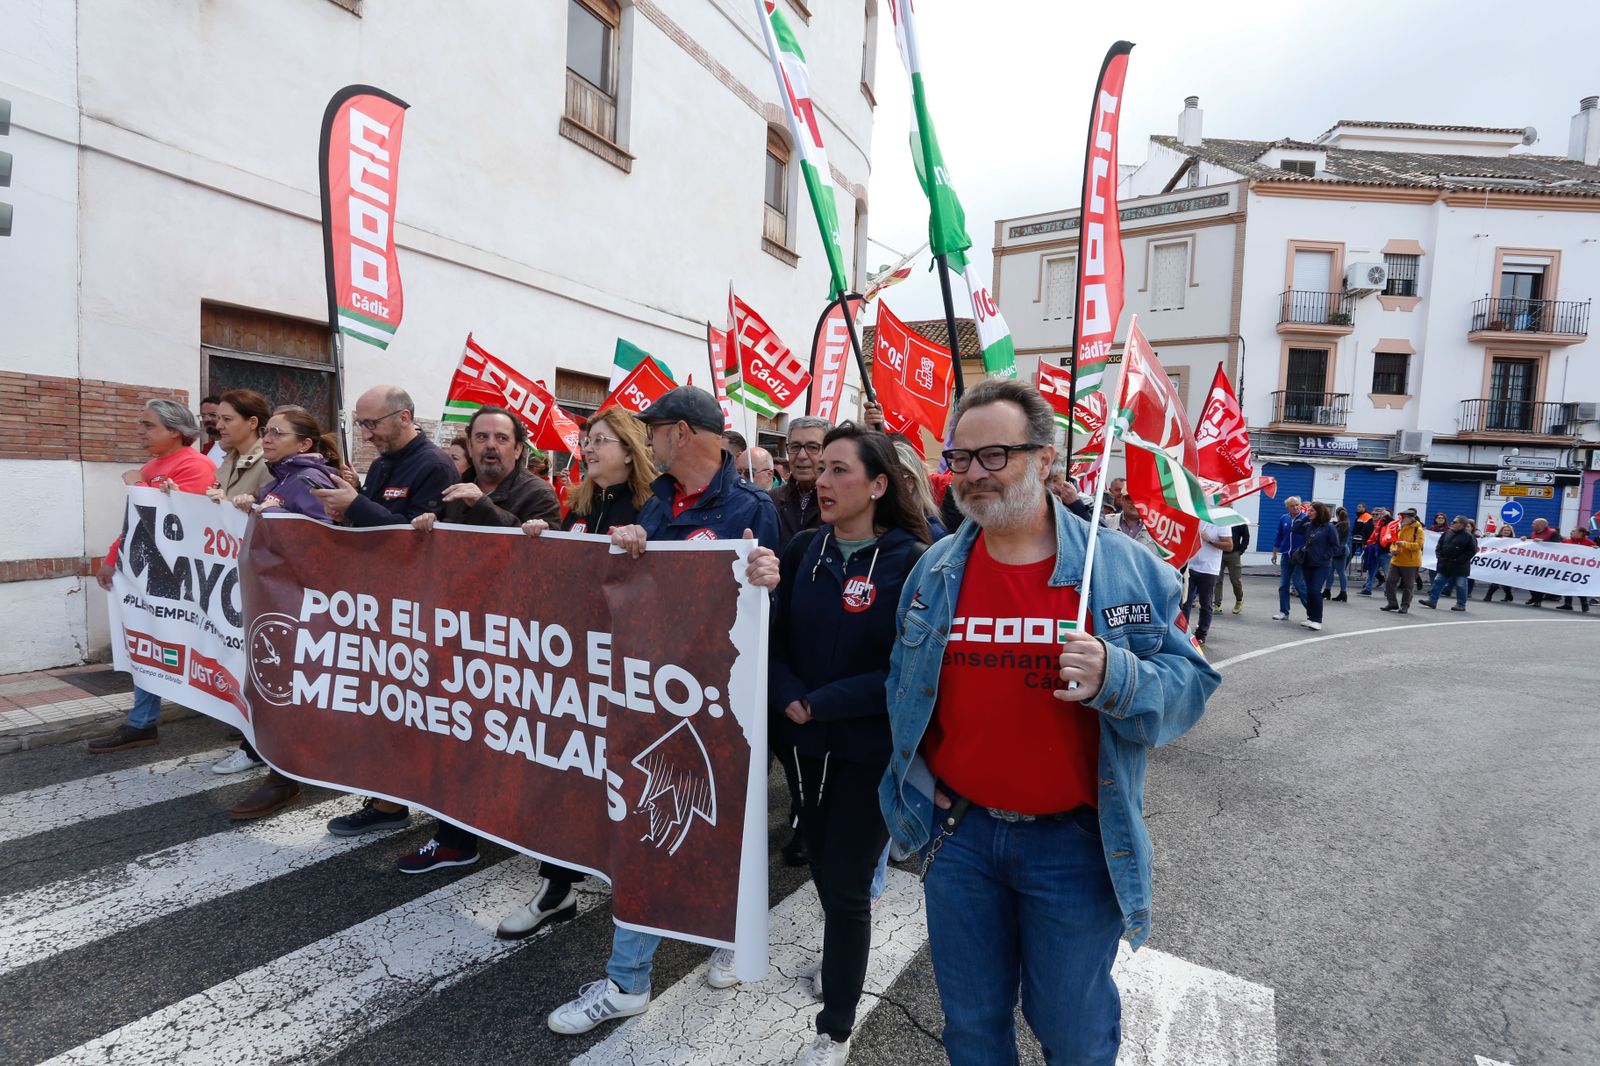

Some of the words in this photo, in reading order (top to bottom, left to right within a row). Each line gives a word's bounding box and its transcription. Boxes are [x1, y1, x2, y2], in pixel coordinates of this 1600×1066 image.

[349, 107, 389, 299] CCOO
[351, 292, 389, 318] Cádiz
[1079, 339, 1112, 361] Cádiz
[750, 359, 791, 401] Cádiz
[624, 383, 652, 412] PSO
[1470, 556, 1512, 571] RSIÓN
[1513, 564, 1591, 585] +EMPLEOS
[1108, 615, 1127, 627] CRAZY
[1128, 613, 1150, 623] WIFE
[1111, 605, 1130, 617] LOVE
[1132, 604, 1148, 614] MY
[300, 587, 381, 633] POR
[391, 598, 427, 643] EL
[434, 608, 573, 668] PLENO
[190, 659, 214, 687] UGT
[294, 628, 430, 688] MENOS
[440, 655, 609, 729] JORNAD
[292, 669, 473, 742] MEJORES
